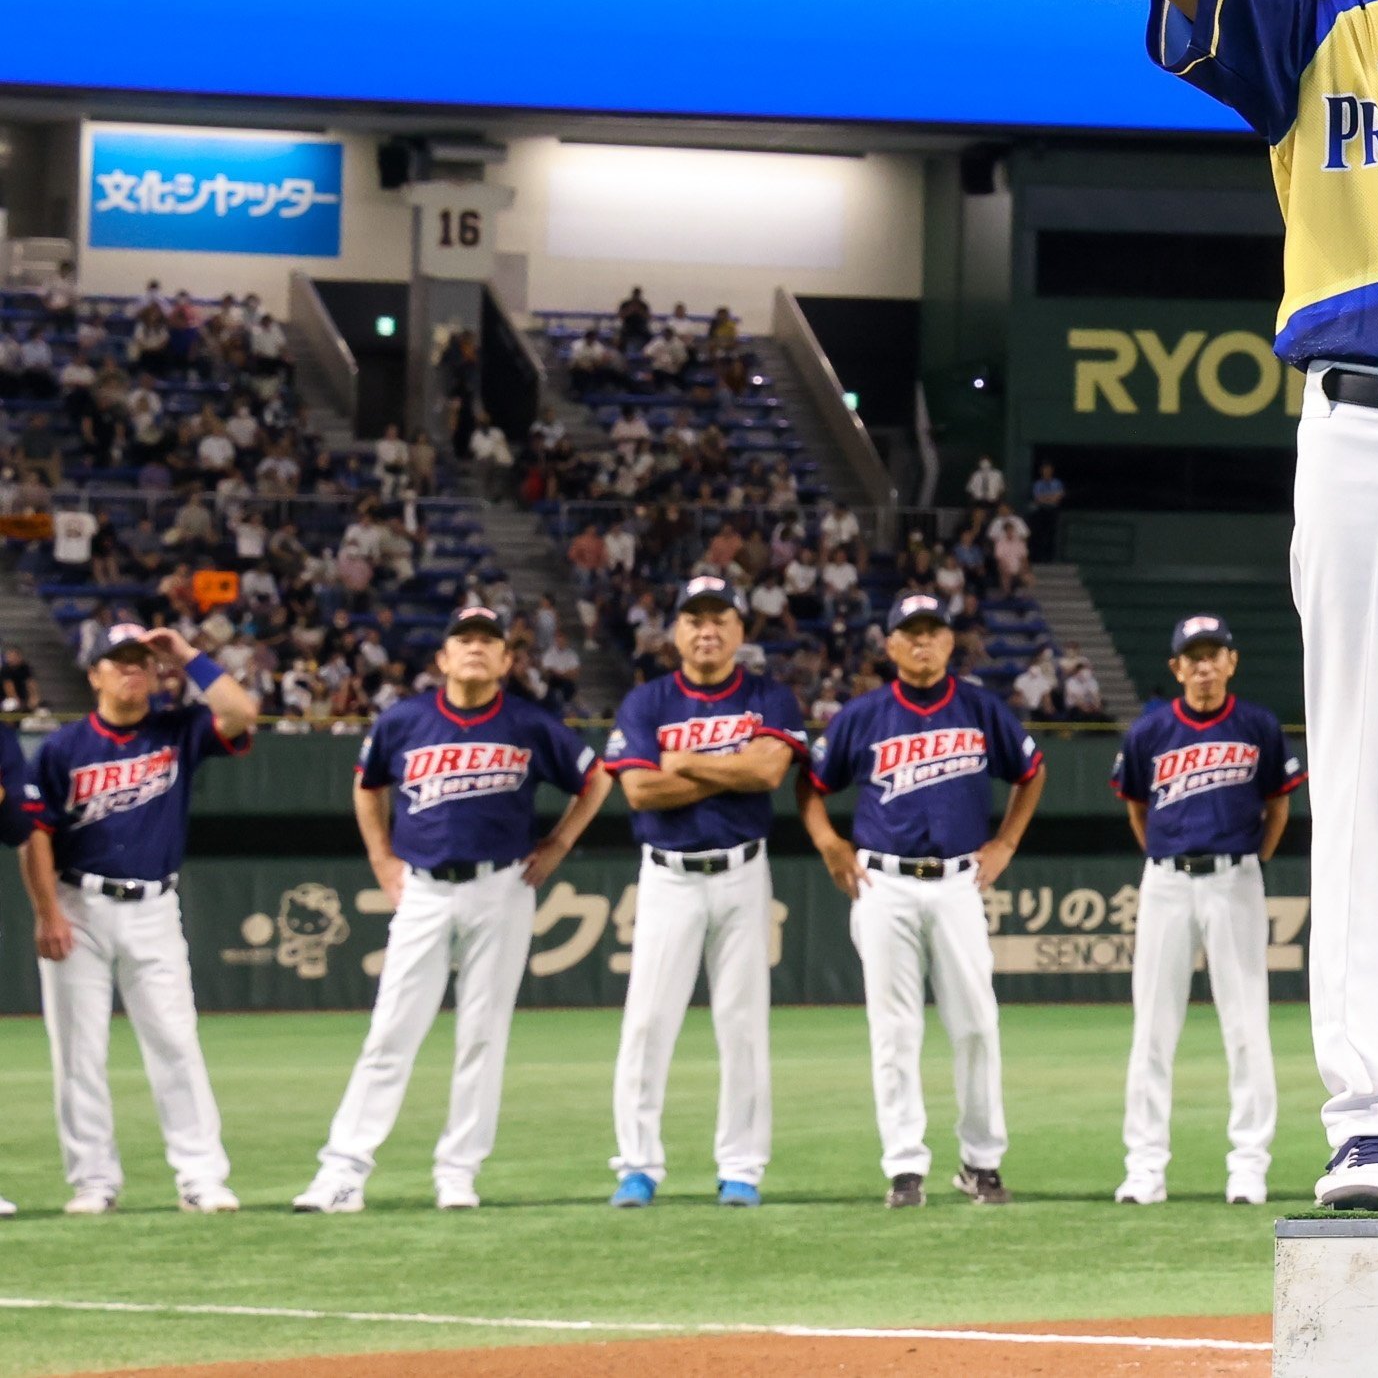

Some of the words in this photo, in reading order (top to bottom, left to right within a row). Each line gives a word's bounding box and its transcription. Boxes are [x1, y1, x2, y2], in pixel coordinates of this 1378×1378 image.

[439, 210, 481, 248] 16
[1067, 328, 1306, 418] RYO
[408, 747, 528, 782] DREAM
[879, 730, 987, 773] DREAM
[1158, 744, 1257, 782] DREAM
